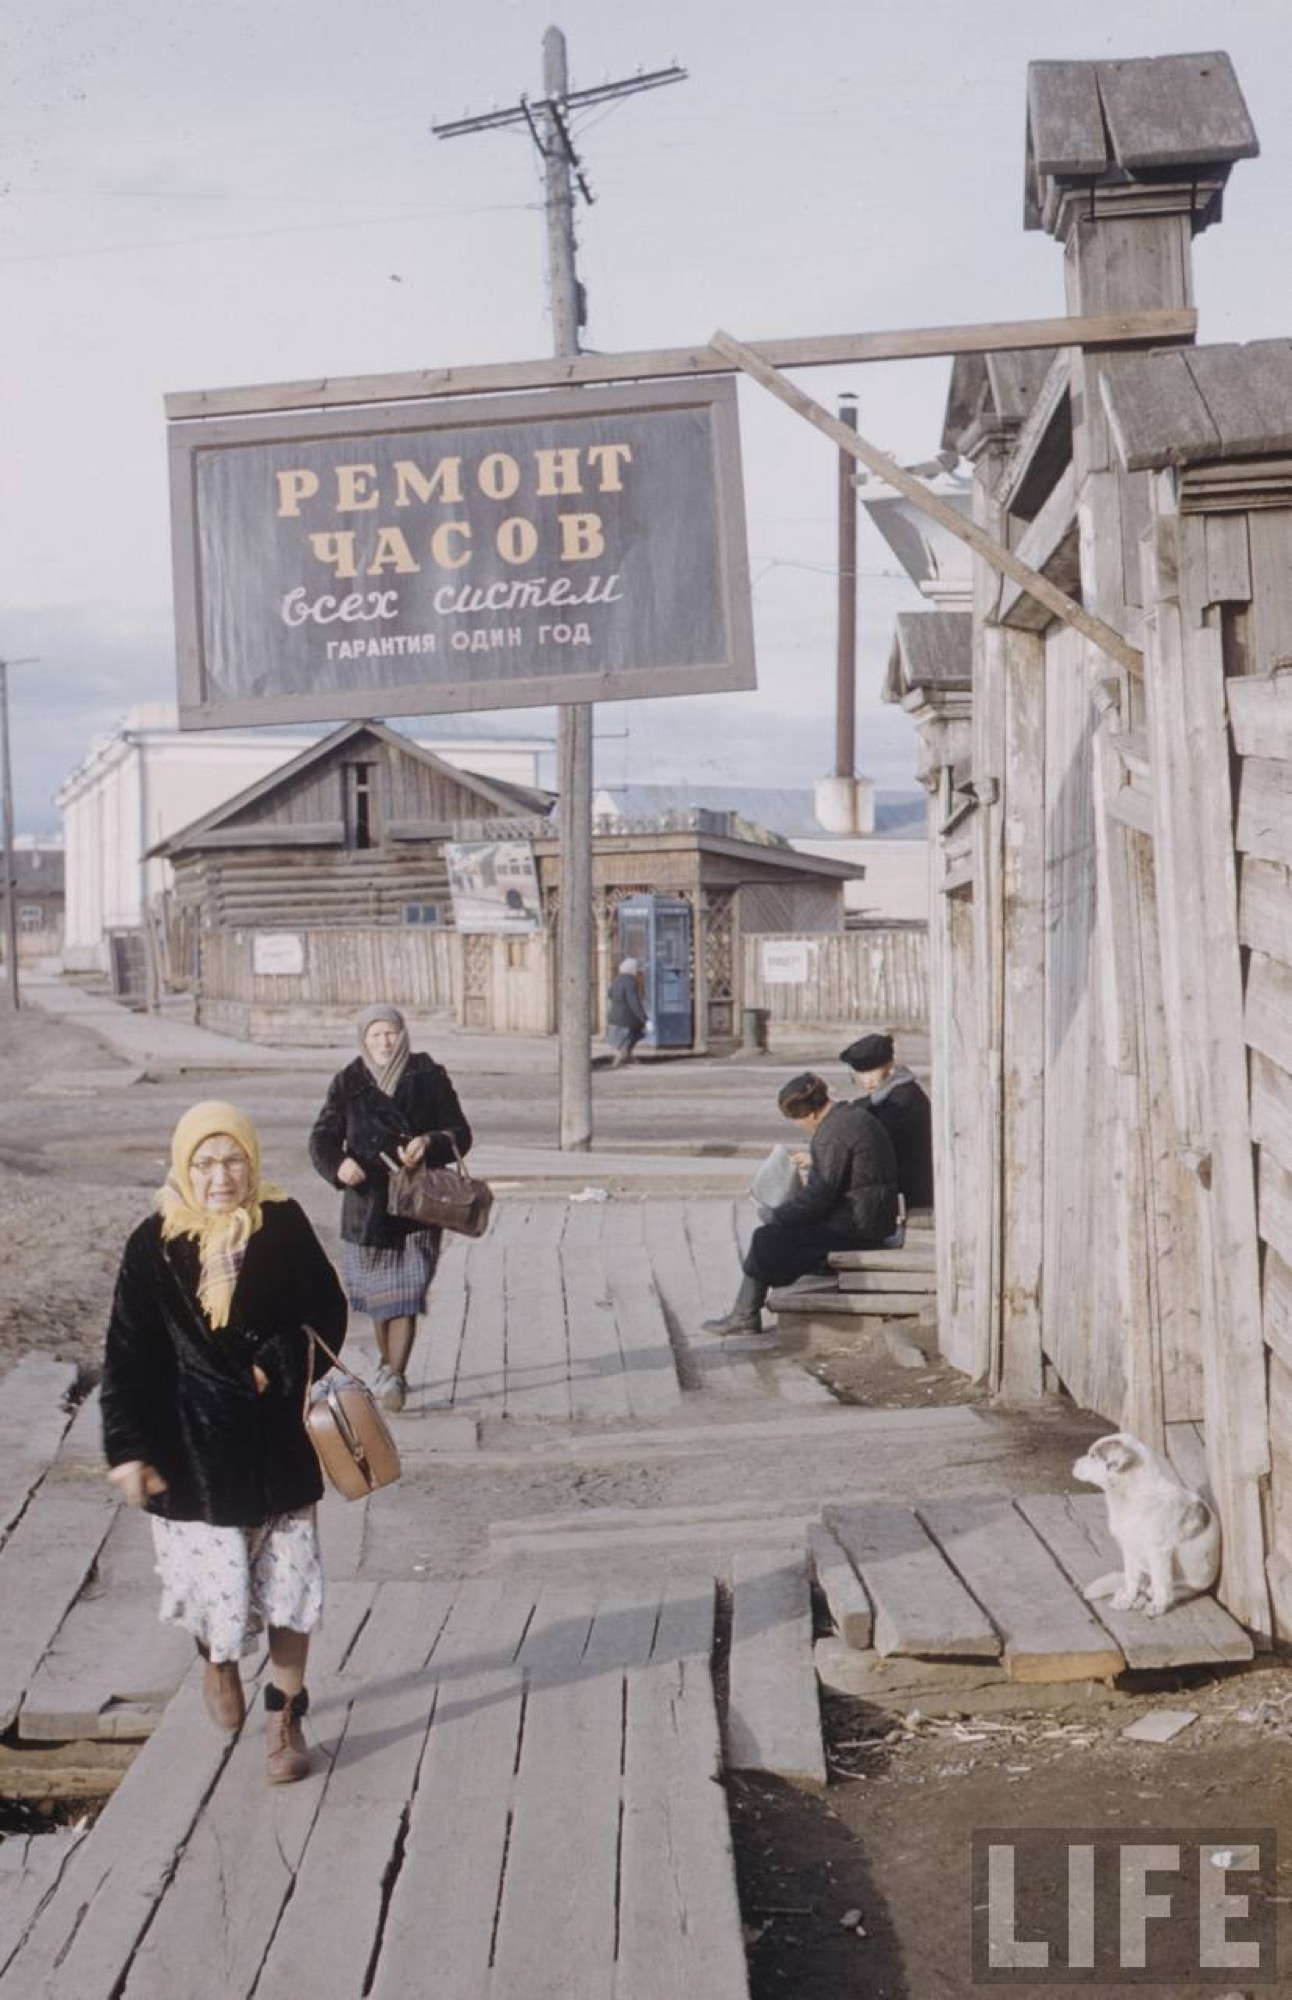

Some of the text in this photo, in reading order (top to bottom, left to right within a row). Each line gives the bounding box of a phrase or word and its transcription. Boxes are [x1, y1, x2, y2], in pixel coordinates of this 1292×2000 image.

[276, 444, 632, 517] РЕМОНТ
[309, 513, 605, 578] ЧАСОВ
[281, 574, 623, 626] всех систем
[327, 622, 592, 660] ГАРАНТИЯ ОДИН ГОД
